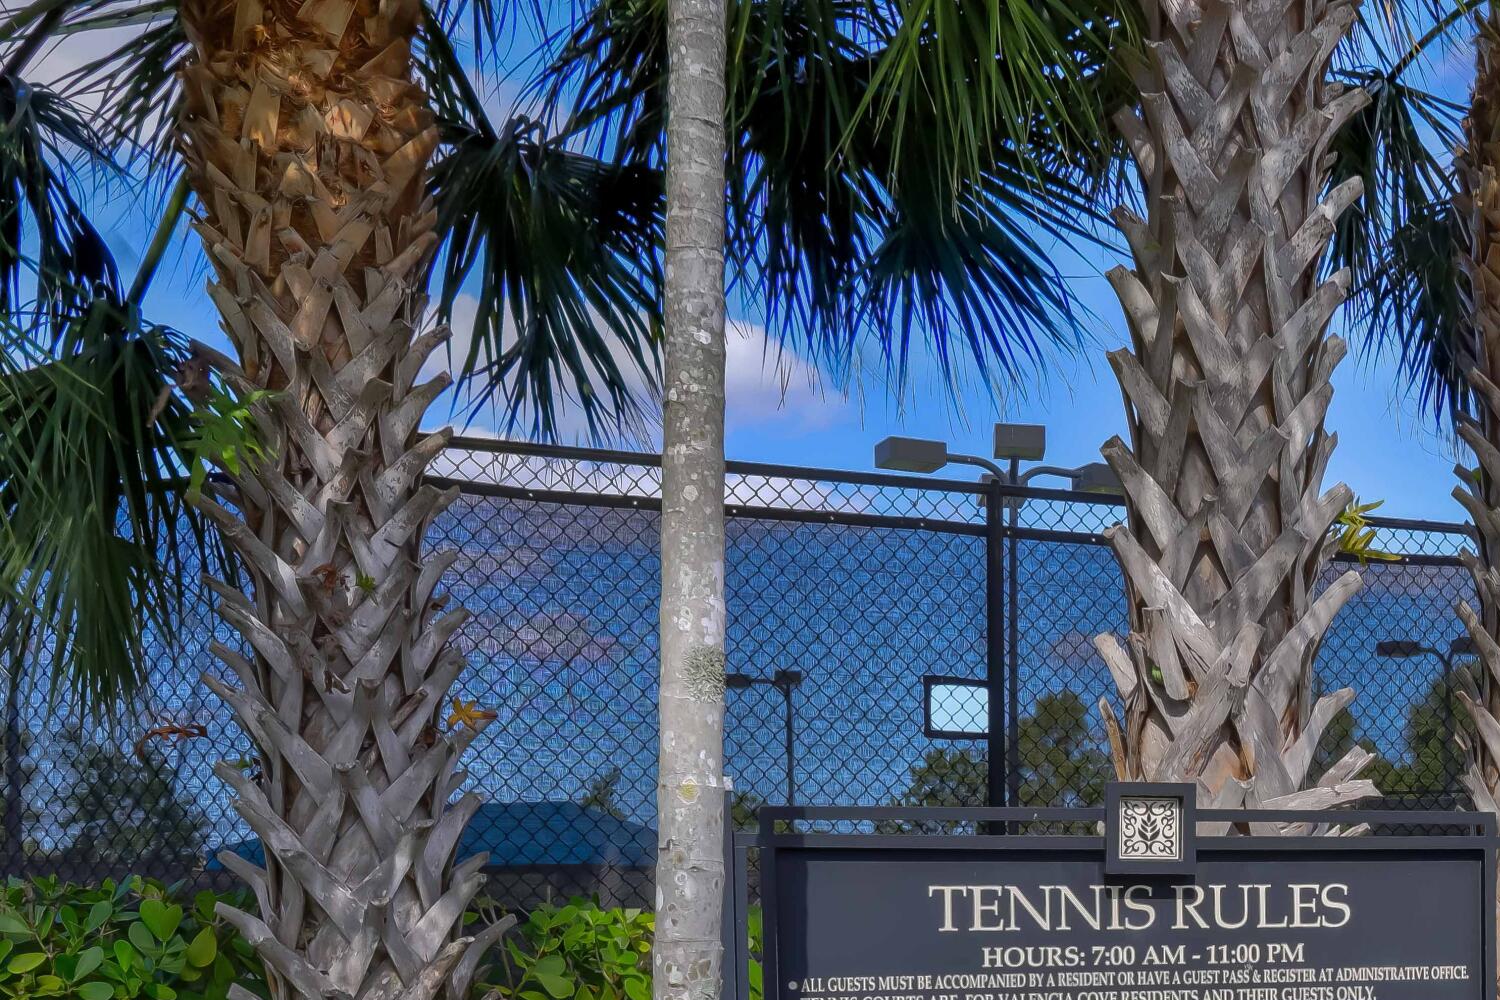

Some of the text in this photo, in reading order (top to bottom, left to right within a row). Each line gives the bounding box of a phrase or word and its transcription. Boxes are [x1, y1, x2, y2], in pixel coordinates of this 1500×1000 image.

[928, 883, 1351, 932] TENNIS RULES
[981, 945, 1086, 968] HOURS:
[1091, 945, 1136, 966] 7:00
[1141, 944, 1187, 966] AM
[1206, 943, 1261, 965] 11:00
[1266, 942, 1305, 963] PM
[801, 965, 1470, 993] ALL GUESTS MUST BE ACCOMPANIED BY A RESIDENT OR HAVE A GUEST PASS & REGISTER AT ADMINISTRATIVE OFFICE.
